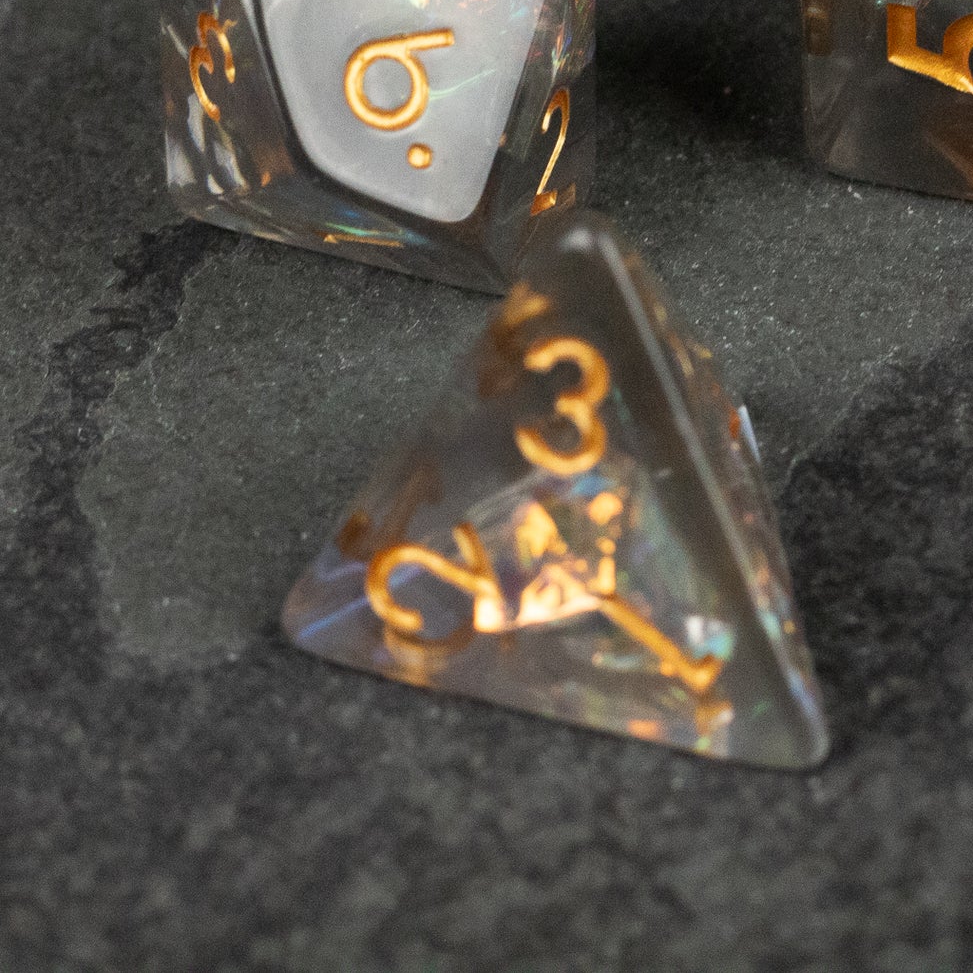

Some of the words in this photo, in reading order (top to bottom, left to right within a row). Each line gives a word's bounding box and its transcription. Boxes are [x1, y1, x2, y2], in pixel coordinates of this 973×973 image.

[531, 87, 571, 216] 2
[515, 335, 610, 474] 3
[366, 523, 505, 635] 2
[598, 592, 724, 691] 1
